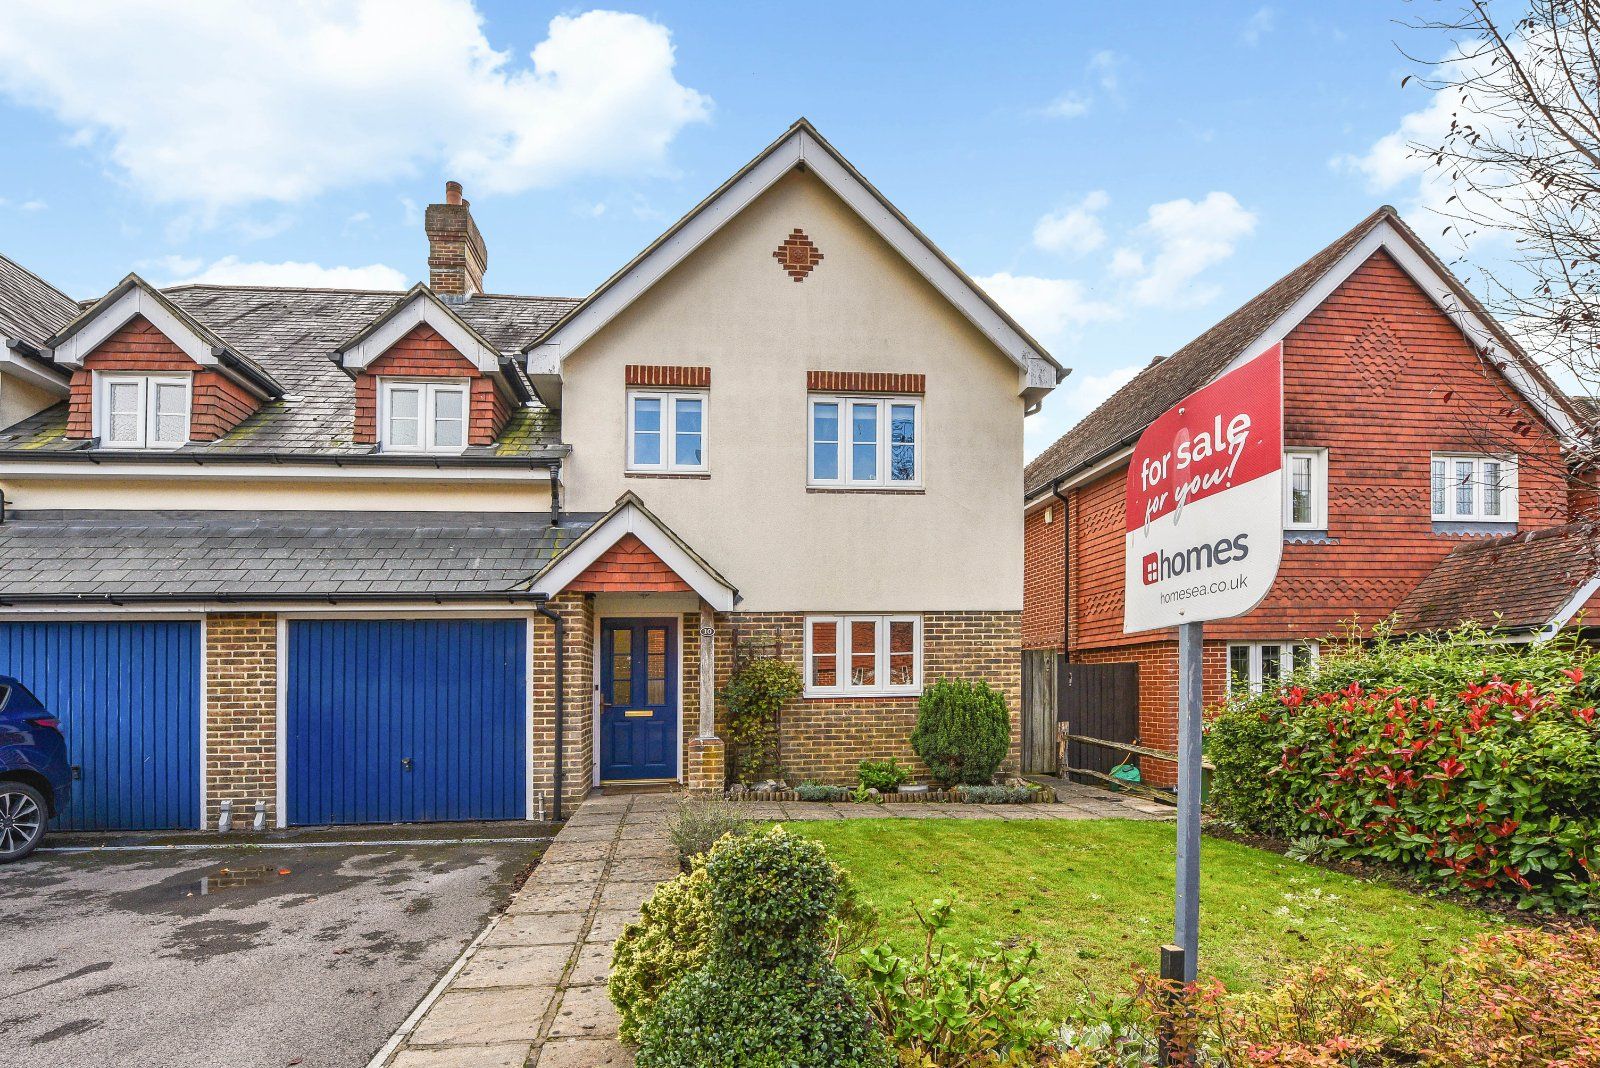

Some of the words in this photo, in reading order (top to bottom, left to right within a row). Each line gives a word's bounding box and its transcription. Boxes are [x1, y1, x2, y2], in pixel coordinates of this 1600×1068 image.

[1141, 450, 1171, 491] for
[1176, 413, 1251, 470] sale
[1144, 490, 1168, 538] for
[1173, 430, 1250, 526] you!
[1160, 532, 1249, 582] homes
[1160, 574, 1248, 605] homesea.co.uk
